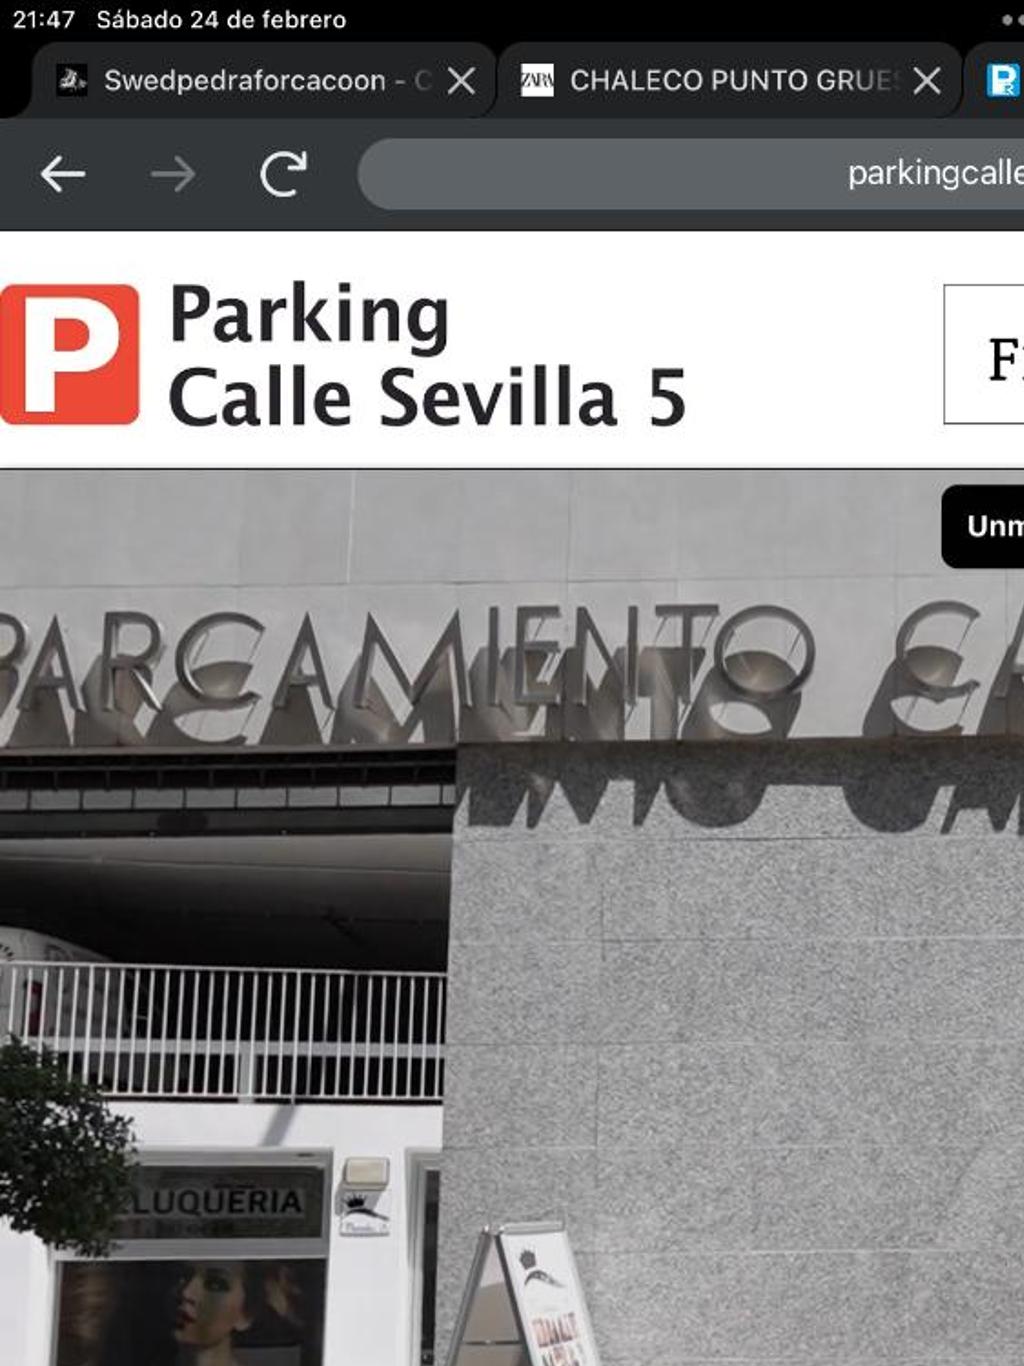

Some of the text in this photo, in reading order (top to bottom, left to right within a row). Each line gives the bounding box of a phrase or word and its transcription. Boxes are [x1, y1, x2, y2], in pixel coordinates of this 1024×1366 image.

[13, 9, 346, 29] 21:47 Sábado 24 de febrero
[105, 67, 385, 95] Swedpedraforcacoon
[521, 72, 554, 88] ZARA
[571, 68, 703, 92] CHALECO
[712, 69, 808, 92] PUNTO
[173, 280, 447, 358] Parking
[24, 297, 120, 413] P
[169, 364, 685, 427] Calle Sevilla 5
[121, 1189, 303, 1215] LUQUERIA
